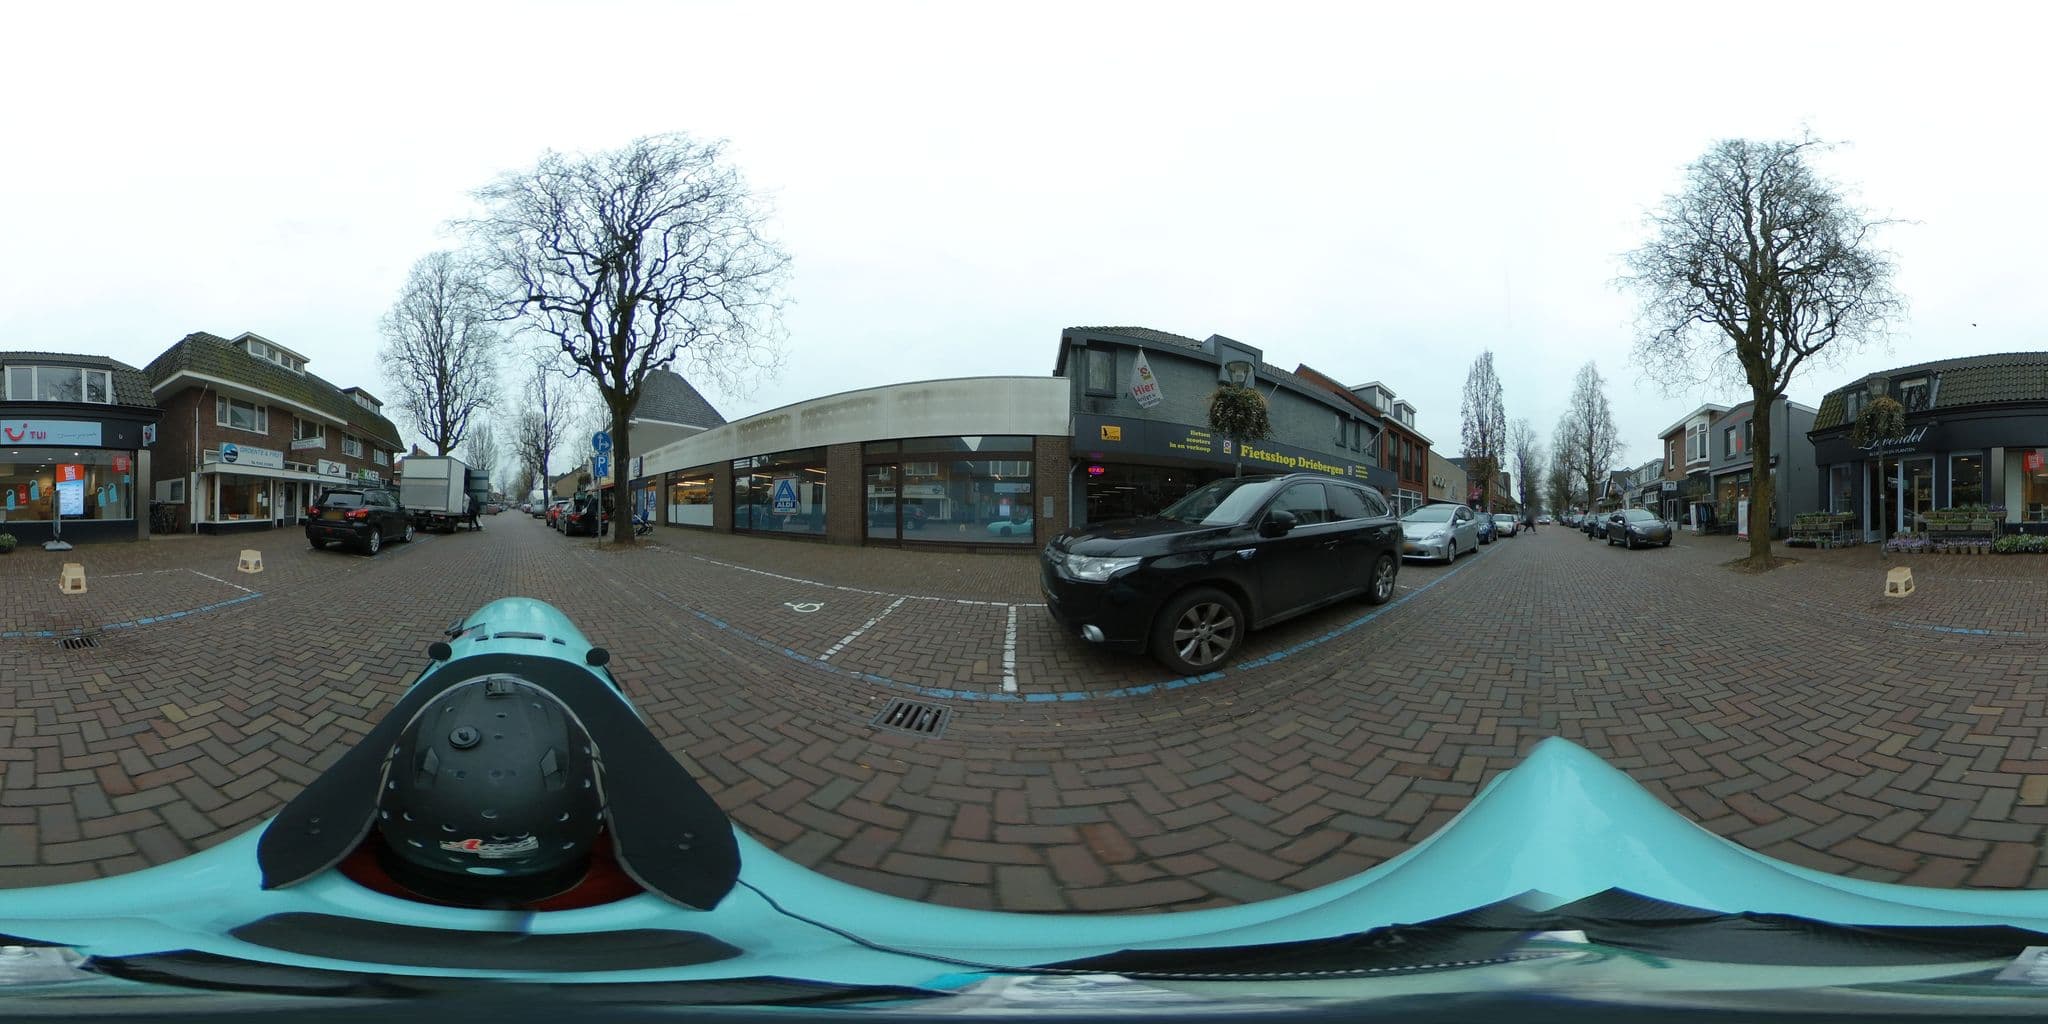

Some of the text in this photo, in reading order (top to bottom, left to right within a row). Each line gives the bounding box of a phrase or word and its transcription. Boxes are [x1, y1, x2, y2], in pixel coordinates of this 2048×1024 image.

[1133, 383, 1154, 396] Hier
[30, 431, 46, 440] TUI
[598, 456, 606, 468] P
[1240, 444, 1344, 476] Fietsshop Driebergen
